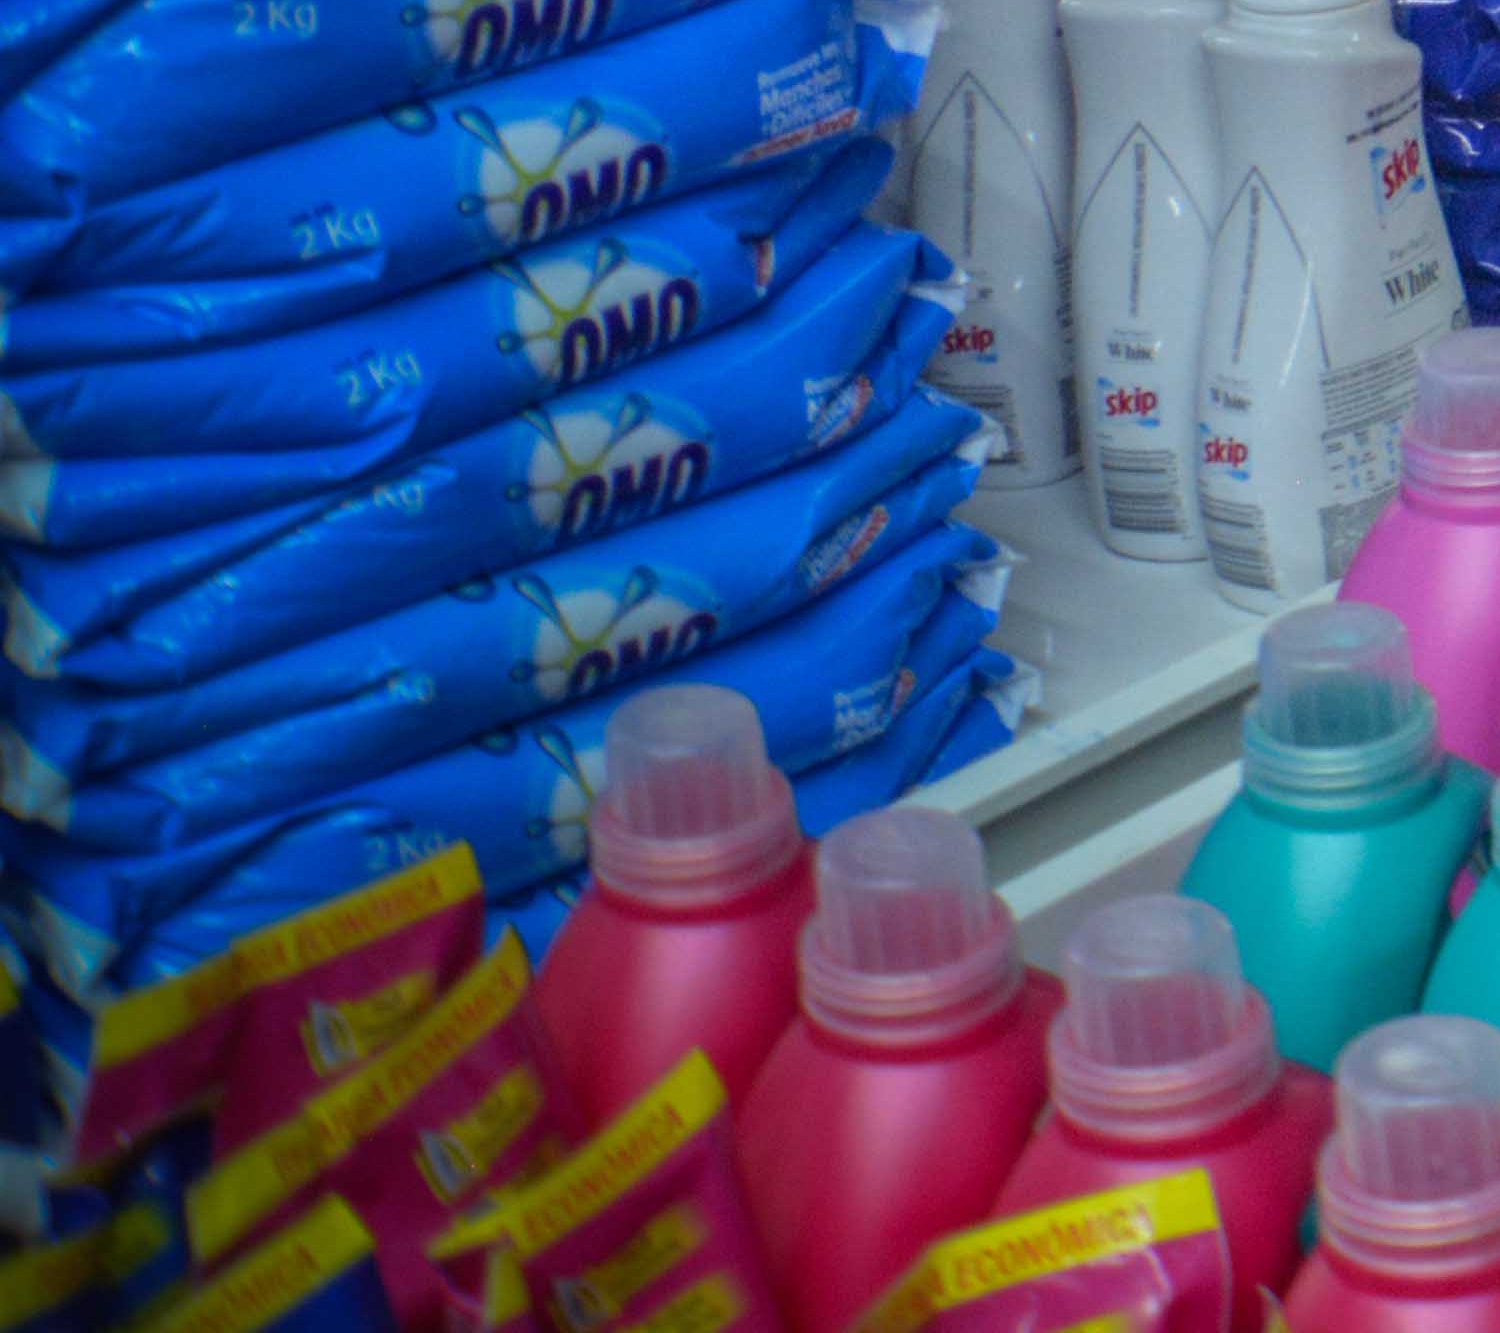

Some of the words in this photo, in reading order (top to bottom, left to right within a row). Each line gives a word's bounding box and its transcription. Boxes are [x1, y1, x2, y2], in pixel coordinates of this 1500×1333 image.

[519, 140, 667, 241] OMO
[1383, 137, 1421, 202] skip
[560, 276, 699, 384] OMO
[941, 322, 995, 356] skip
[1105, 377, 1159, 422] skip
[560, 440, 711, 535] OMO
[1203, 434, 1249, 469] skip
[570, 612, 719, 700] OMO
[952, 1203, 1152, 1288] ECONÓMICA
